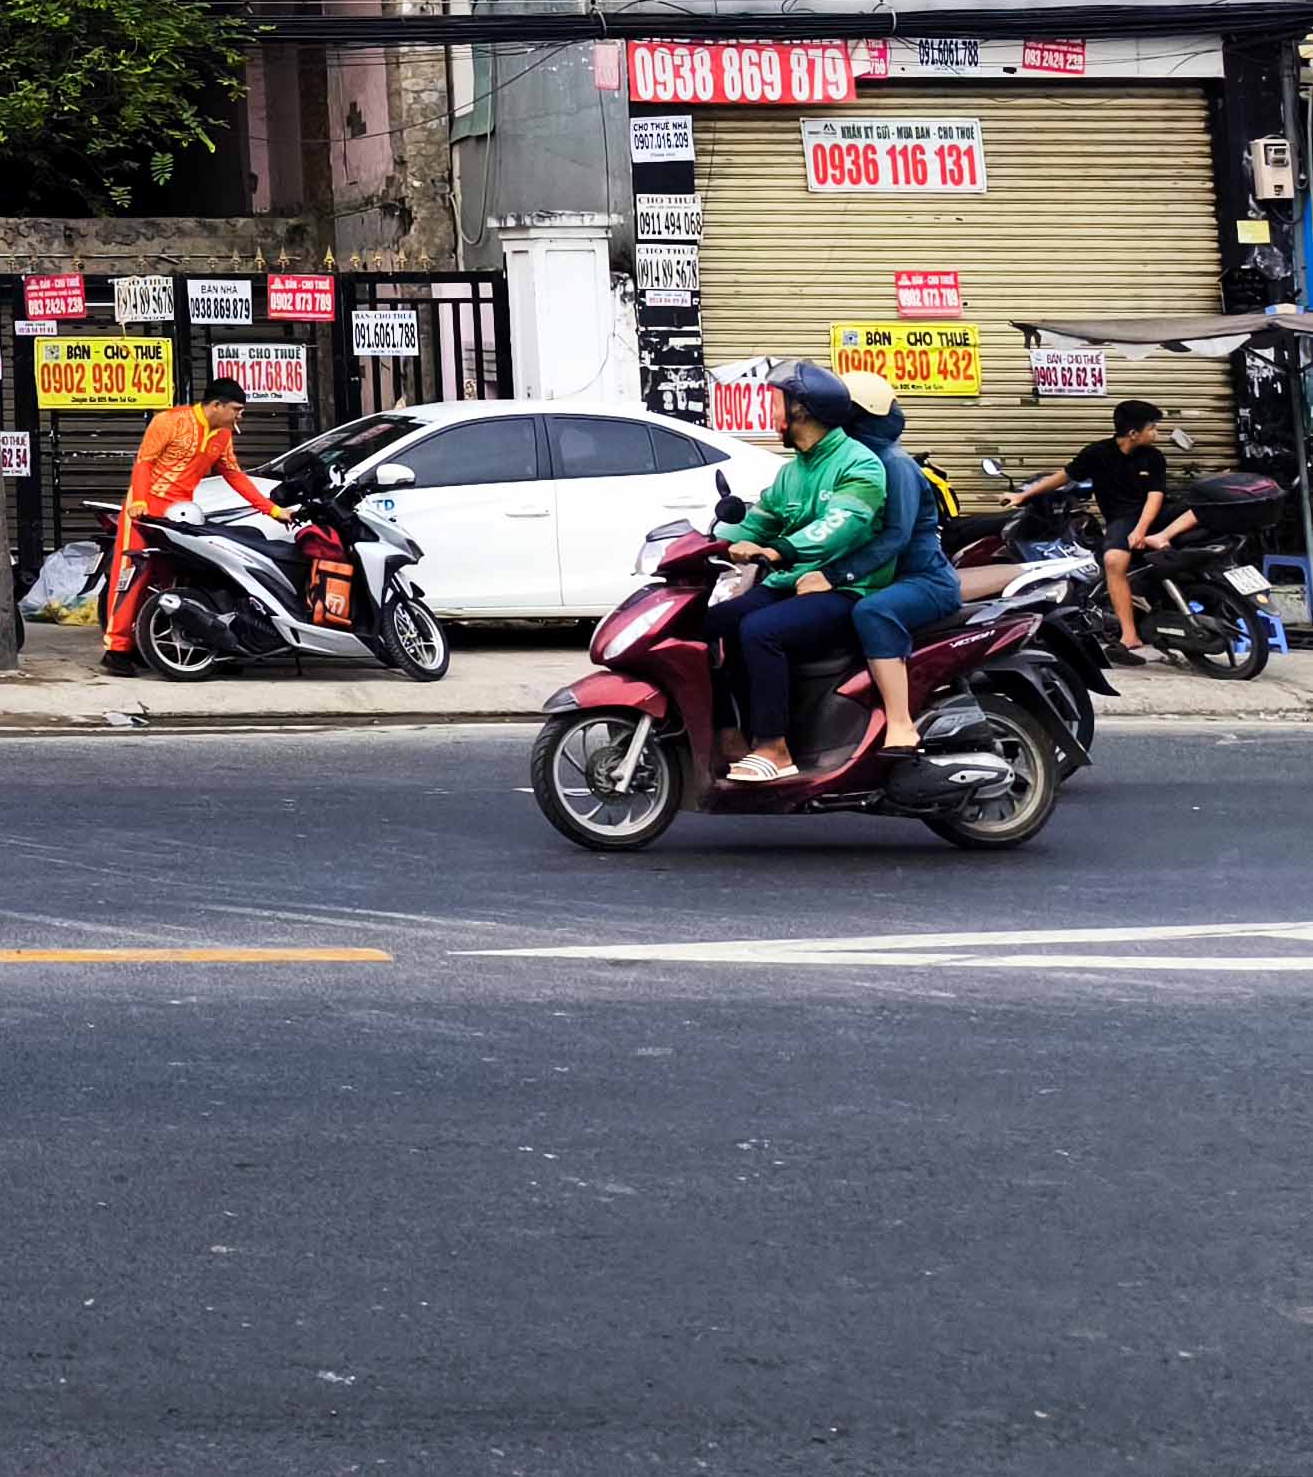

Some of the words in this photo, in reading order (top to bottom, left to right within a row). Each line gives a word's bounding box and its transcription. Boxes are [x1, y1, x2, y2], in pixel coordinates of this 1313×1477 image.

[918, 39, 979, 66] 091.6061.788
[634, 47, 715, 102] 0938
[721, 47, 783, 102] 869
[790, 47, 848, 102] 879
[633, 123, 649, 132] CHO
[812, 143, 880, 186] 0936
[886, 143, 928, 186] 116
[934, 144, 977, 186] 131
[639, 212, 662, 235] 0911
[664, 212, 682, 235] 494
[684, 212, 703, 235] 068
[637, 258, 660, 289] 0914
[661, 258, 674, 289] 89
[675, 258, 699, 289] 5678
[354, 322, 417, 349] 091.6061.788
[865, 328, 892, 347] BÁN
[906, 331, 933, 347] CHO
[936, 329, 971, 347] THUÊ
[66, 341, 91, 360] BÁN
[104, 344, 130, 360] CHO
[134, 340, 163, 360] THUÊ
[217, 346, 240, 359] BÁN
[248, 347, 273, 359] CHO
[274, 345, 302, 359] THUÊ
[40, 363, 87, 394] 0902
[92, 363, 126, 394] 930
[131, 362, 166, 394] 432
[895, 349, 930, 381] 930
[938, 350, 975, 381] 432
[1060, 367, 1074, 387] 62
[1075, 367, 1089, 387] 62
[1090, 367, 1104, 387] 54
[714, 382, 753, 431] 0902
[756, 383, 776, 431] 37
[15, 449, 28, 468] 54
